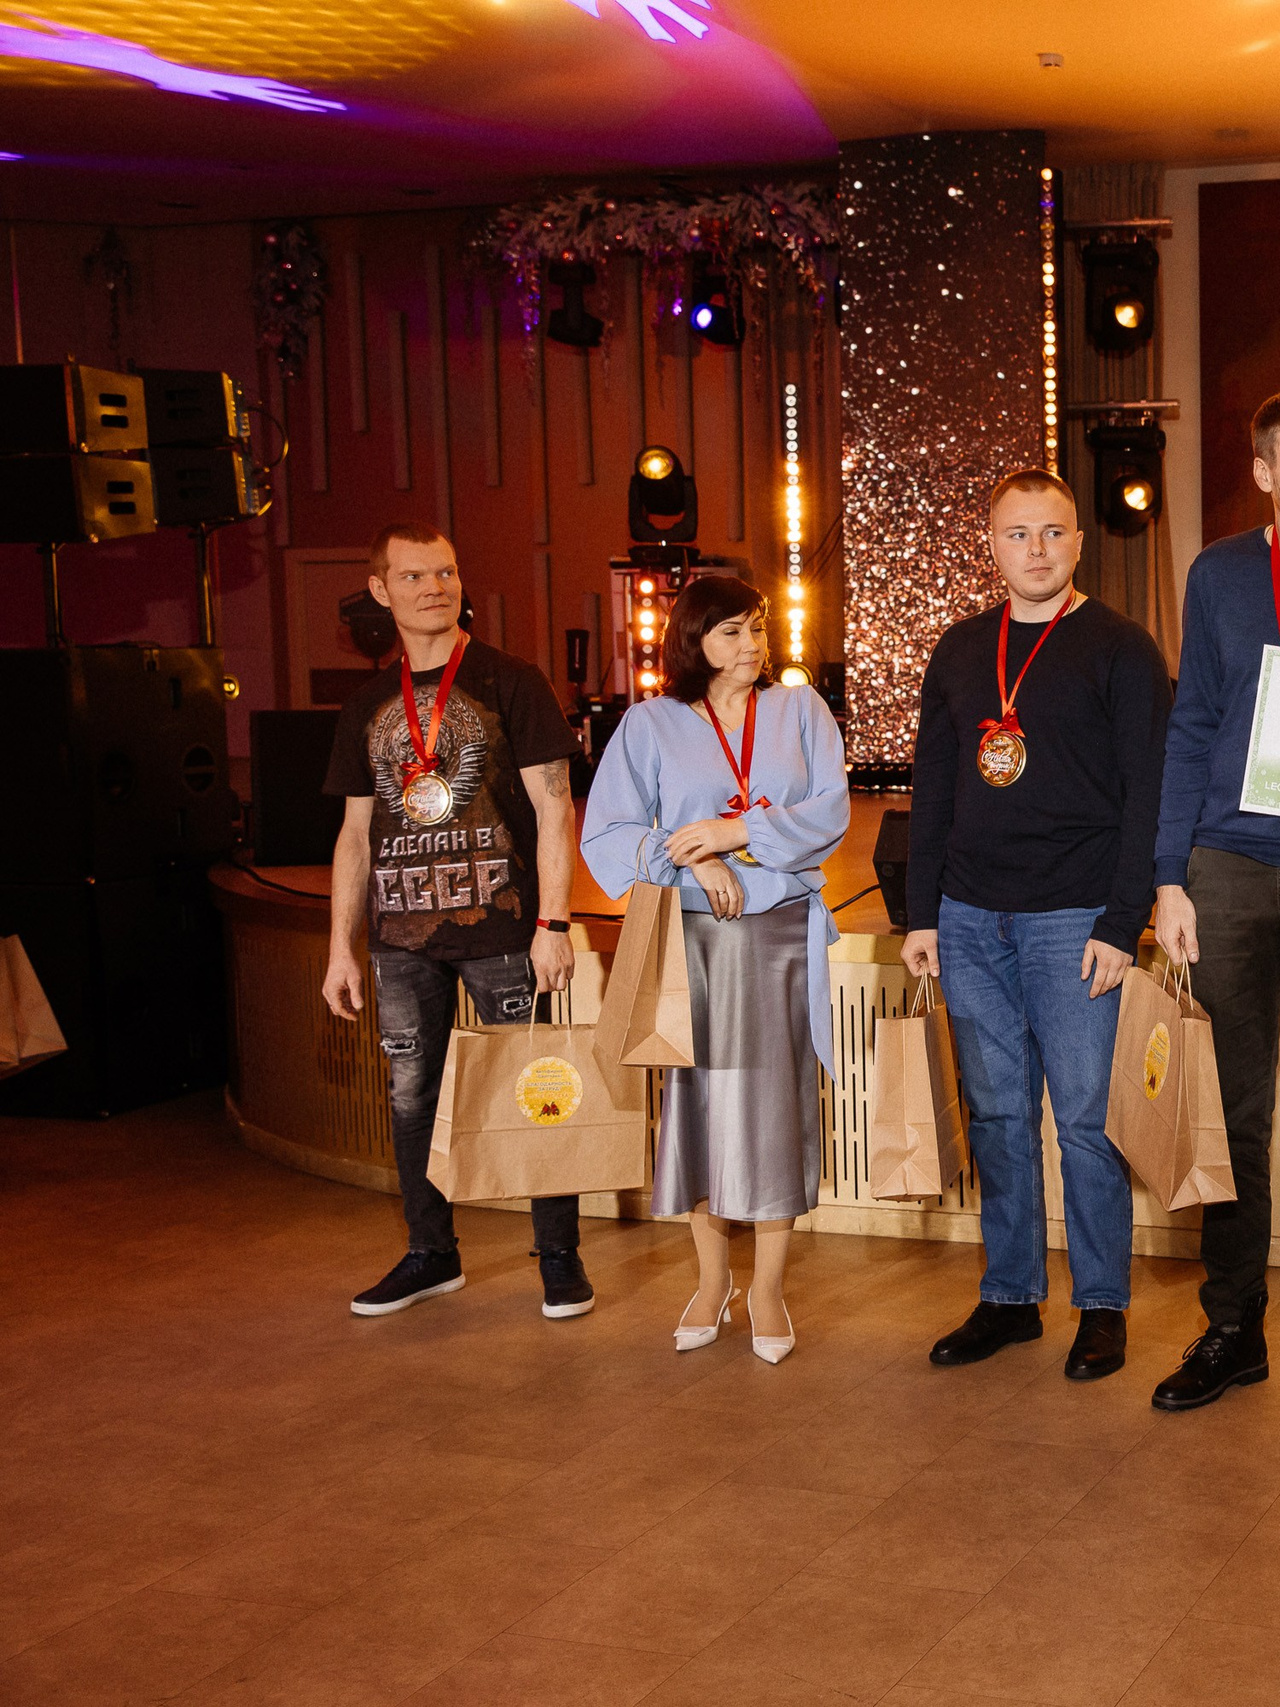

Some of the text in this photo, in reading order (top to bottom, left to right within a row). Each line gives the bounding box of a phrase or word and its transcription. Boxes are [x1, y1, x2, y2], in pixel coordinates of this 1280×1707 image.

[379, 827, 493, 858] СДЕЛАН В
[374, 858, 510, 912] СССР
